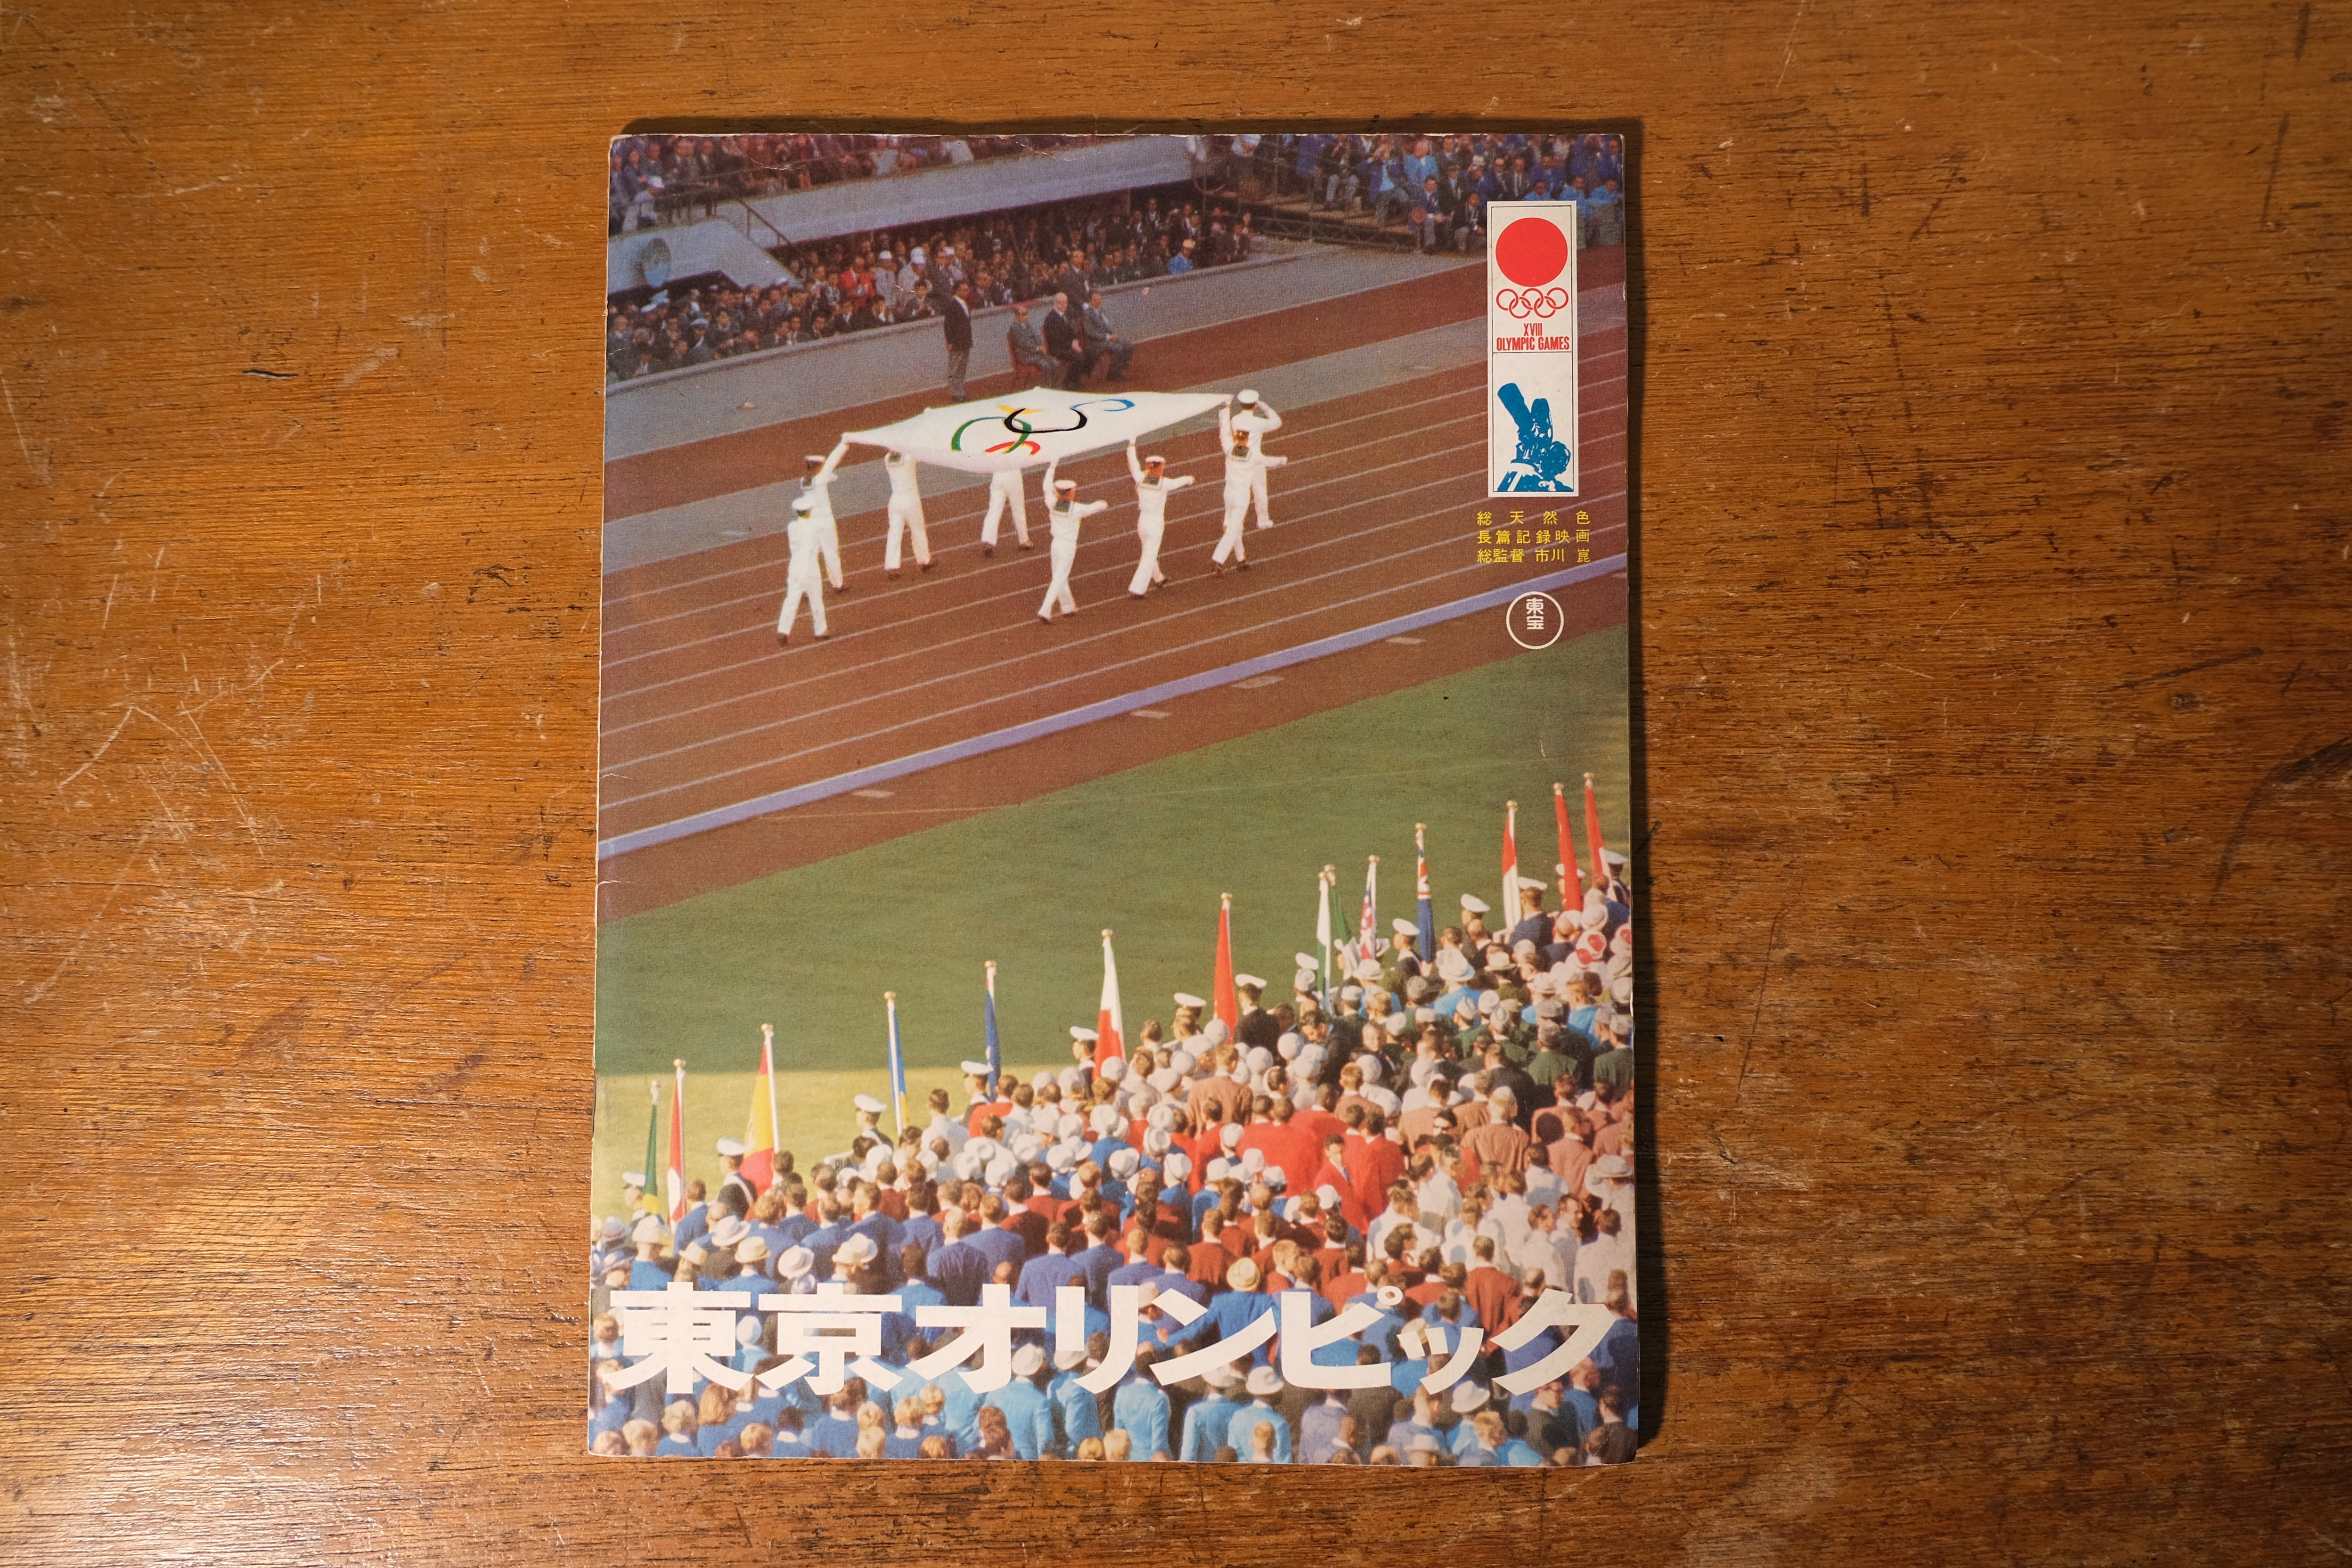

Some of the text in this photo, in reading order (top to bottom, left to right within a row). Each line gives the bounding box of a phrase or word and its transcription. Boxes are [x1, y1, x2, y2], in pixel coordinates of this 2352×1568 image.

[1523, 323, 1543, 336] XVIII
[1496, 336, 1570, 351] OLYMPIC GAMES
[1477, 510, 1591, 526] 総天然色
[1477, 529, 1591, 544] 長篇記録映画
[1477, 548, 1525, 563] 総監督
[1526, 597, 1544, 630] 東宝
[602, 1281, 1616, 1396] 東京オリンピック
